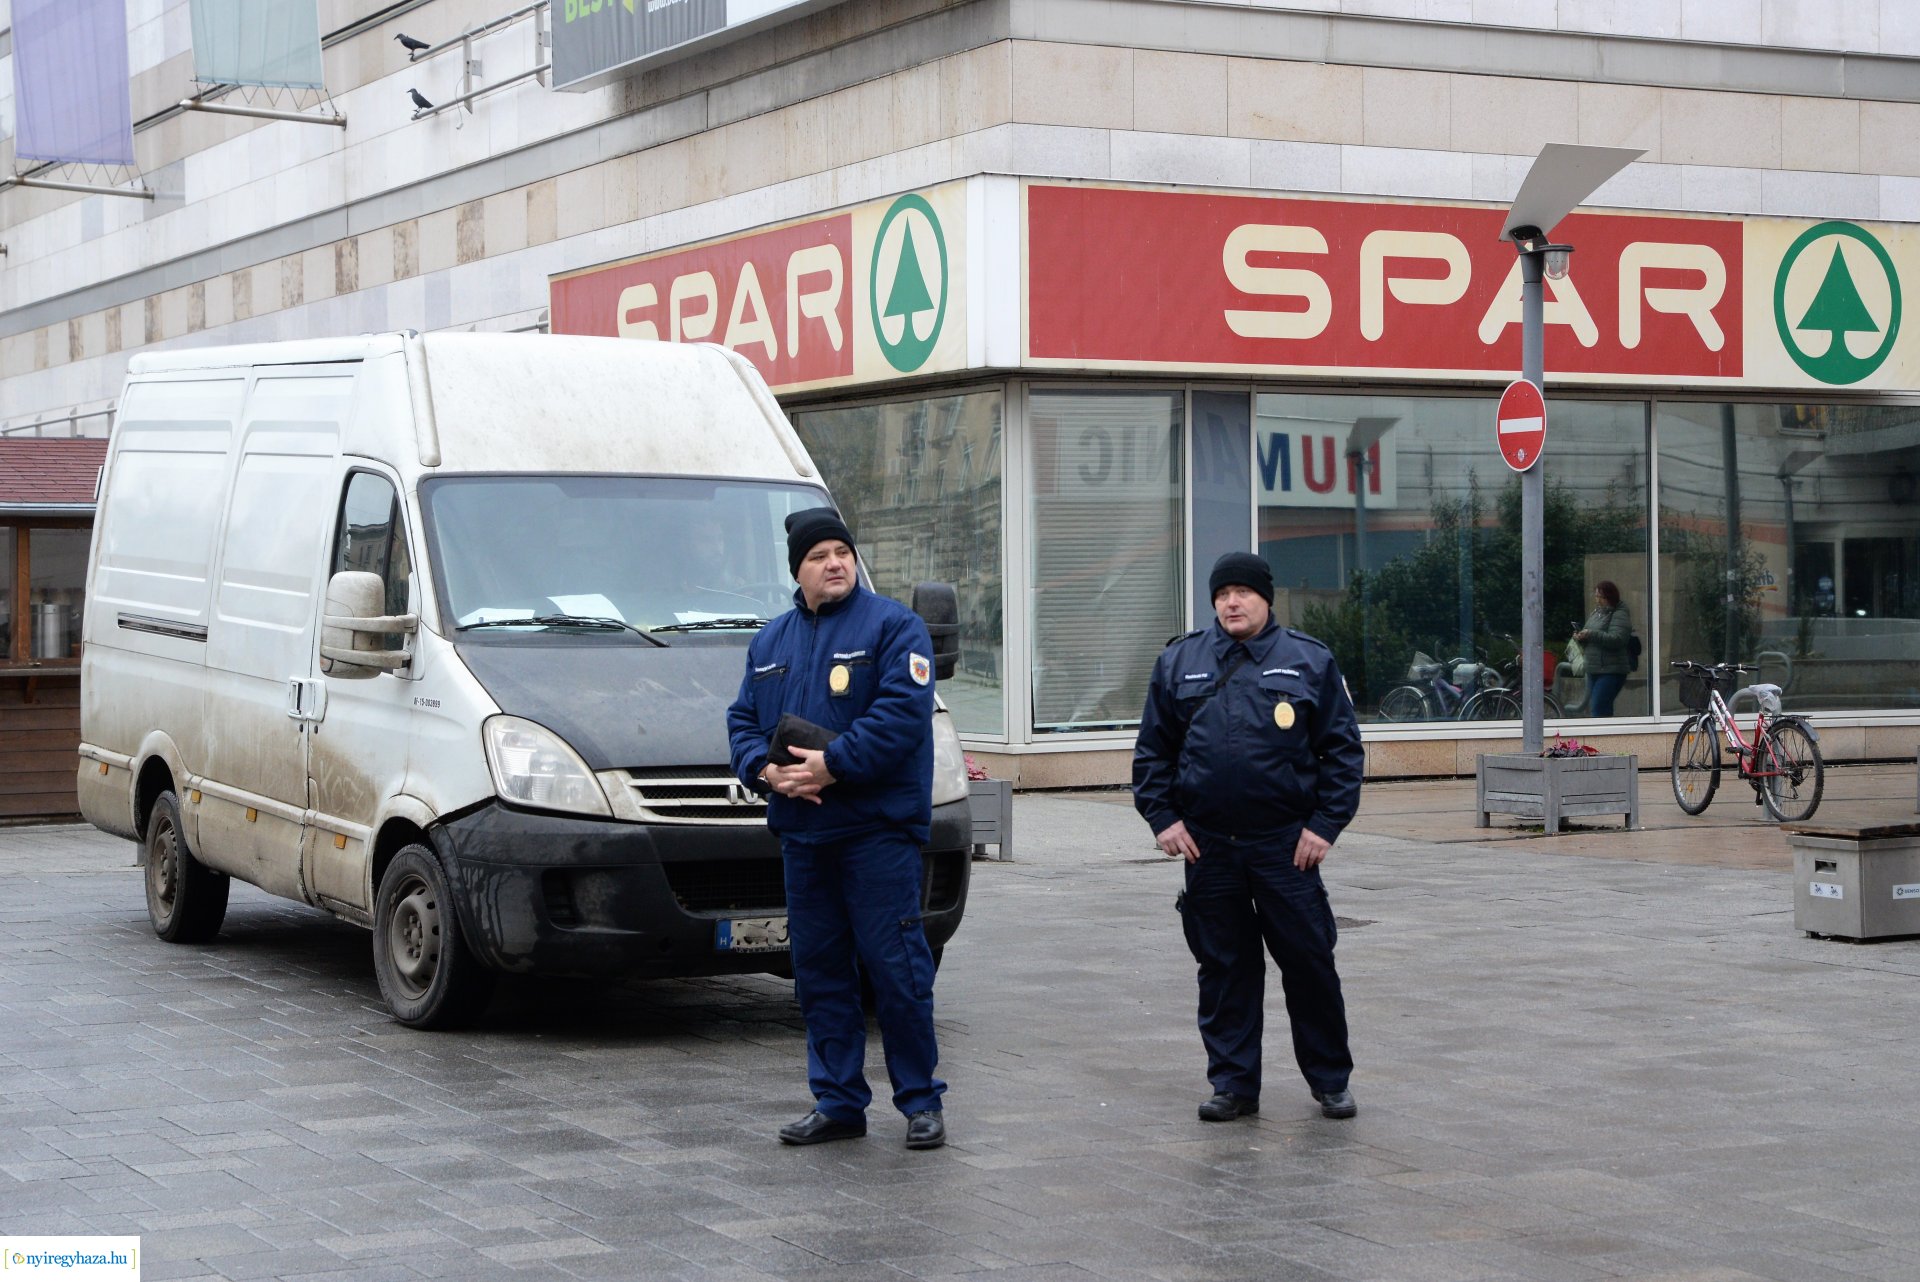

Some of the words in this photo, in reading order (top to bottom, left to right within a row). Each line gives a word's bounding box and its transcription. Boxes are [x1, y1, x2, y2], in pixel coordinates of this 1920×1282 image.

[616, 243, 844, 362] SPAR
[1222, 223, 1727, 352] SPAR
[720, 935, 727, 946] H
